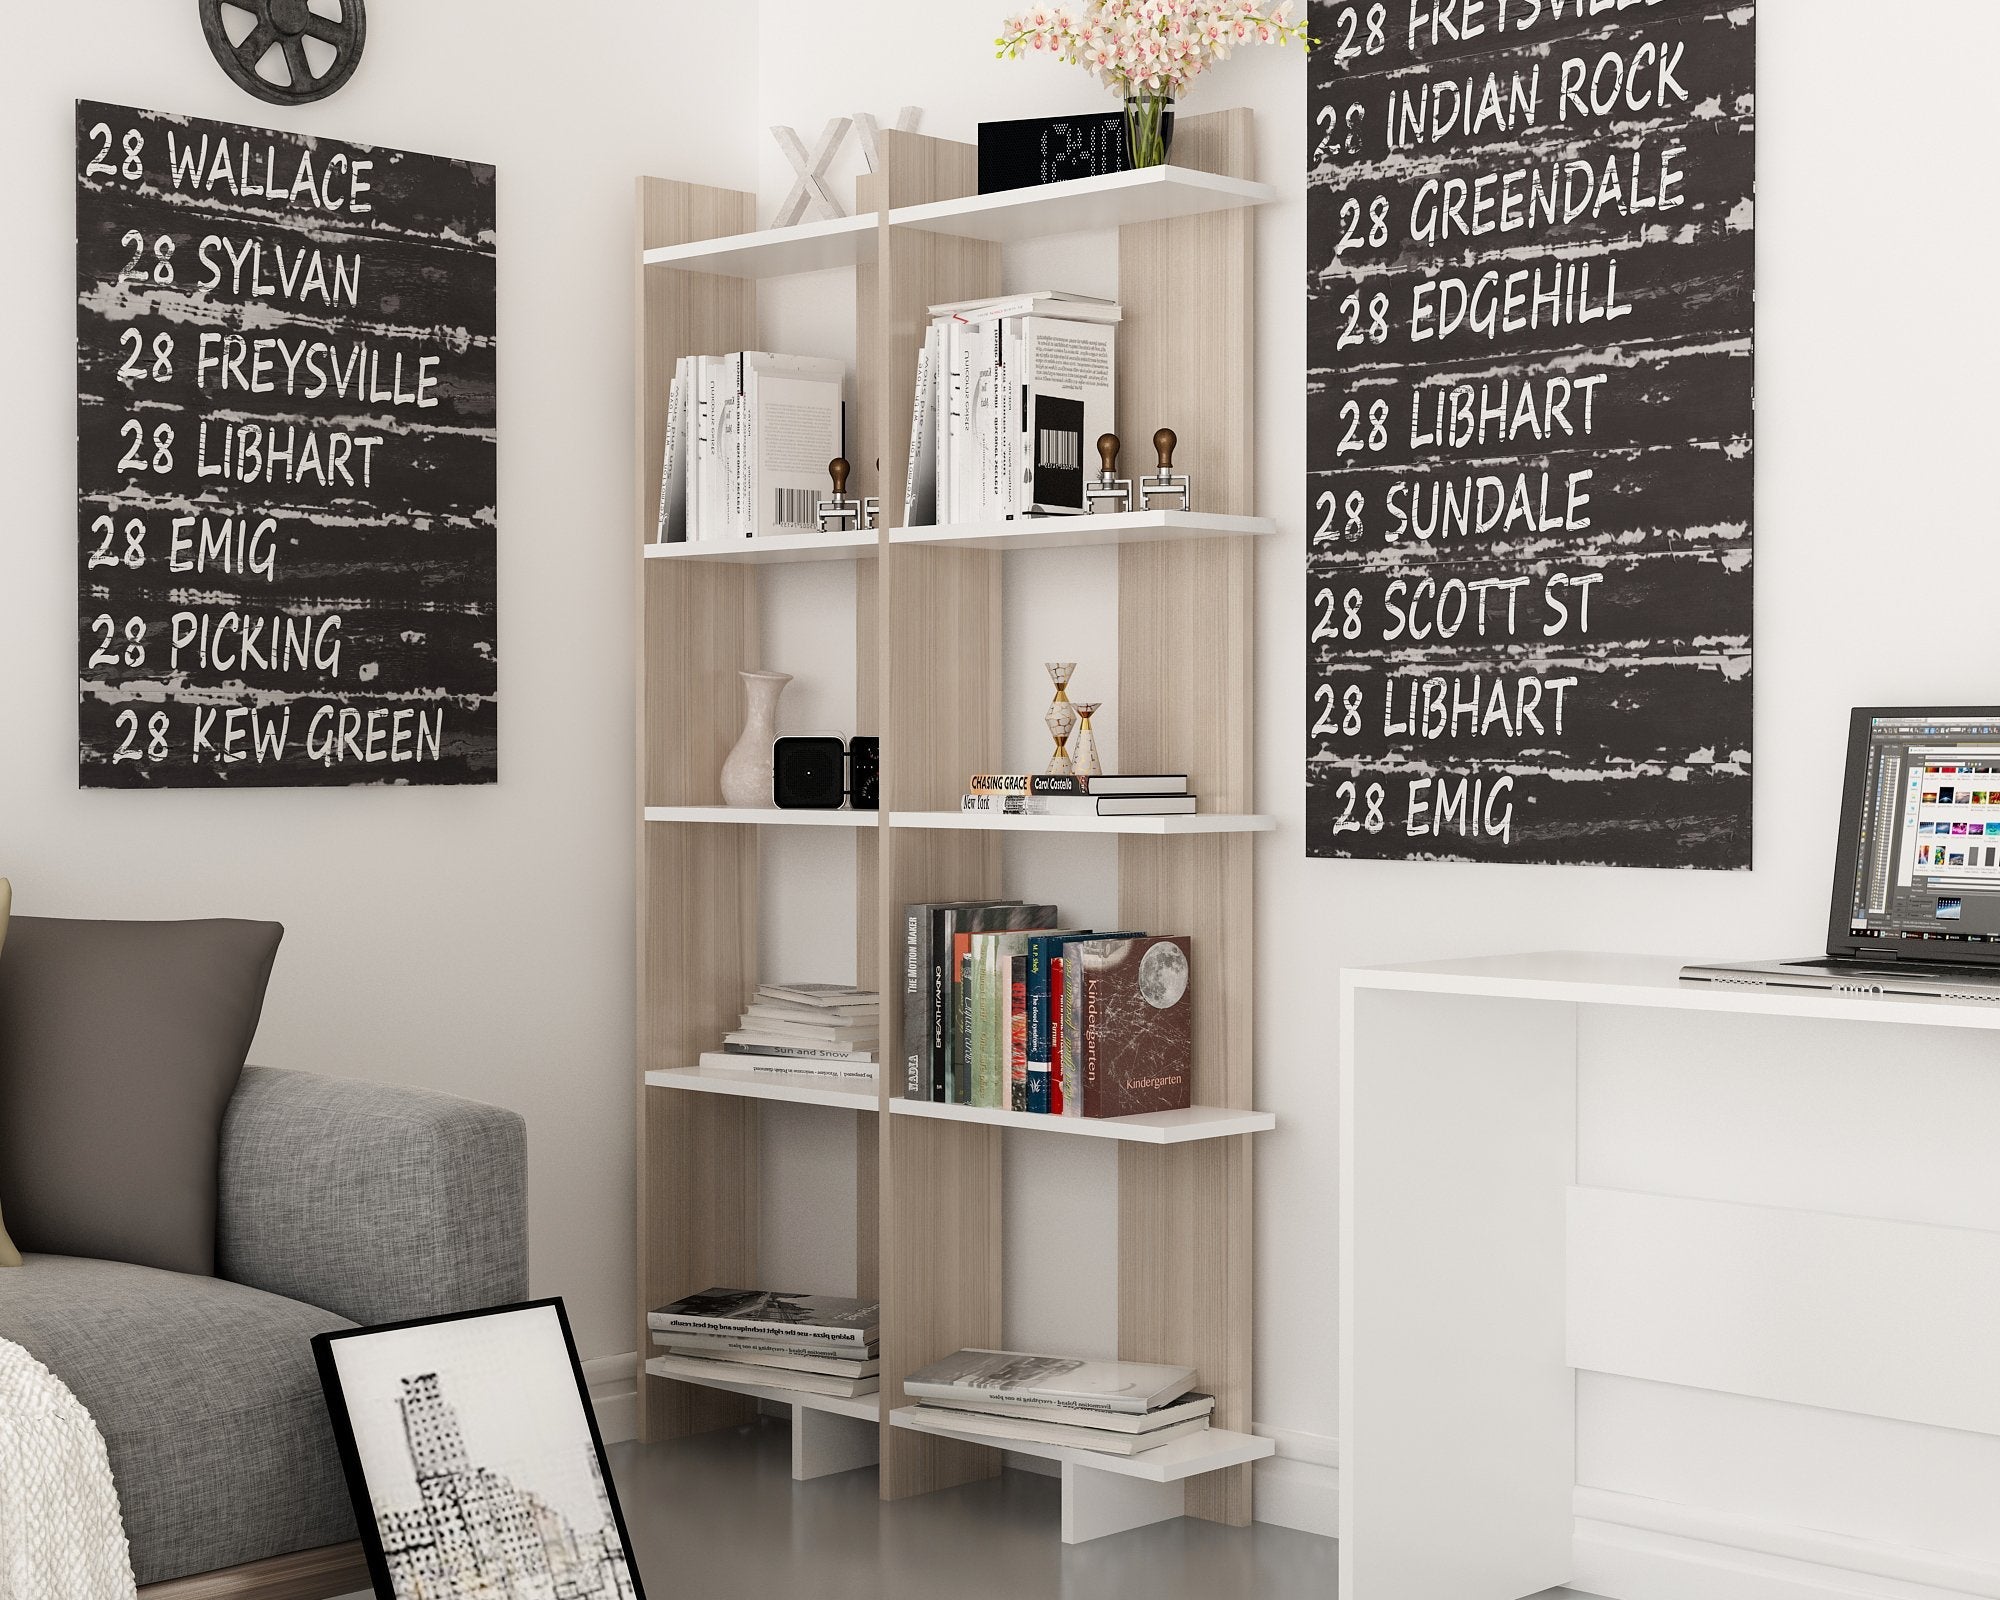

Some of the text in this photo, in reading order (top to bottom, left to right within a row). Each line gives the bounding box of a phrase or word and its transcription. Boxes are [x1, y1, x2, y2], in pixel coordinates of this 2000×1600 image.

[1333, 2, 1388, 62] 28
[1313, 41, 1689, 162] 28 INDIAN ROCK
[86, 122, 374, 214] 28 WALLACE
[1335, 145, 1687, 256] 28 GREENDALE
[118, 229, 361, 308] 28 SYLVAN
[1336, 258, 1633, 351] 28 EDGEHILL
[116, 327, 440, 408] 28 FREYSVILLE
[905, 441, 916, 505] Evermotion
[915, 363, 923, 387] love
[917, 399, 925, 427] and
[1336, 373, 1608, 457] 28 LIBHART
[117, 419, 384, 487] 28 LIBHART
[1312, 469, 1593, 546] 28 SUNDALE
[87, 515, 278, 582] 28 EMIG
[1310, 572, 1604, 644] 28 SCOTT ST
[88, 611, 342, 677] 28 PICKING
[112, 704, 443, 767] 28 KEW GREEN
[1311, 674, 1578, 740] 28 LIBHART
[963, 795, 976, 809] New
[977, 795, 990, 809] York
[971, 775, 1003, 790] CHASING
[1004, 775, 1028, 790] GRACE
[1034, 777, 1049, 790] Carol
[1332, 775, 1514, 845] 28 EMIG
[907, 917, 917, 994] THE MOTION MAKER
[796, 1048, 816, 1056] and
[819, 1050, 849, 1058] Snow
[1086, 980, 1098, 1081] Kindergarten
[1126, 1074, 1183, 1090] Kindergarten
